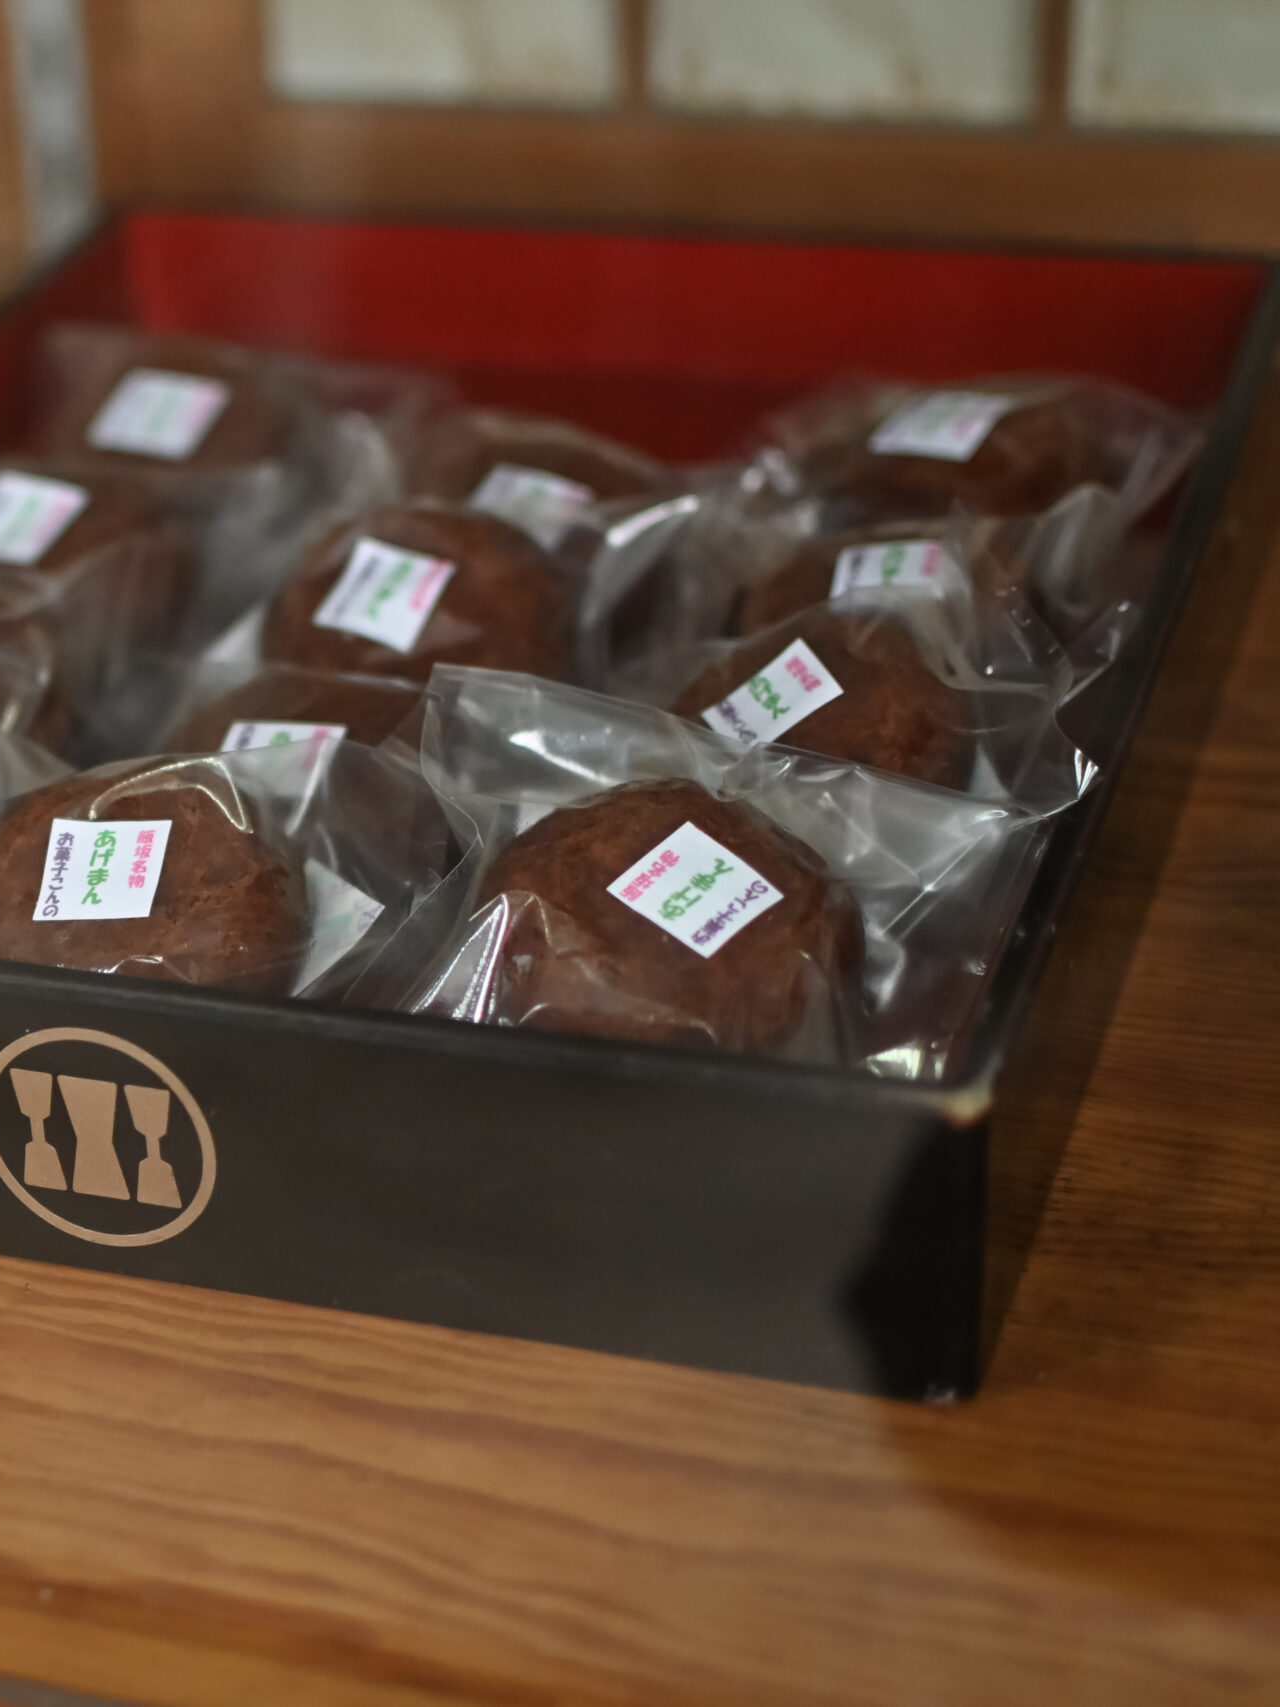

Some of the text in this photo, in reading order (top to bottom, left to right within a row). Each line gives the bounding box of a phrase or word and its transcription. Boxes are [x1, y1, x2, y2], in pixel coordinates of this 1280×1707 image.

[42, 831, 75, 918] お菓子こんの
[81, 829, 118, 905] あげまん
[127, 829, 157, 889] 飯坂名物
[658, 858, 734, 921] あげまん
